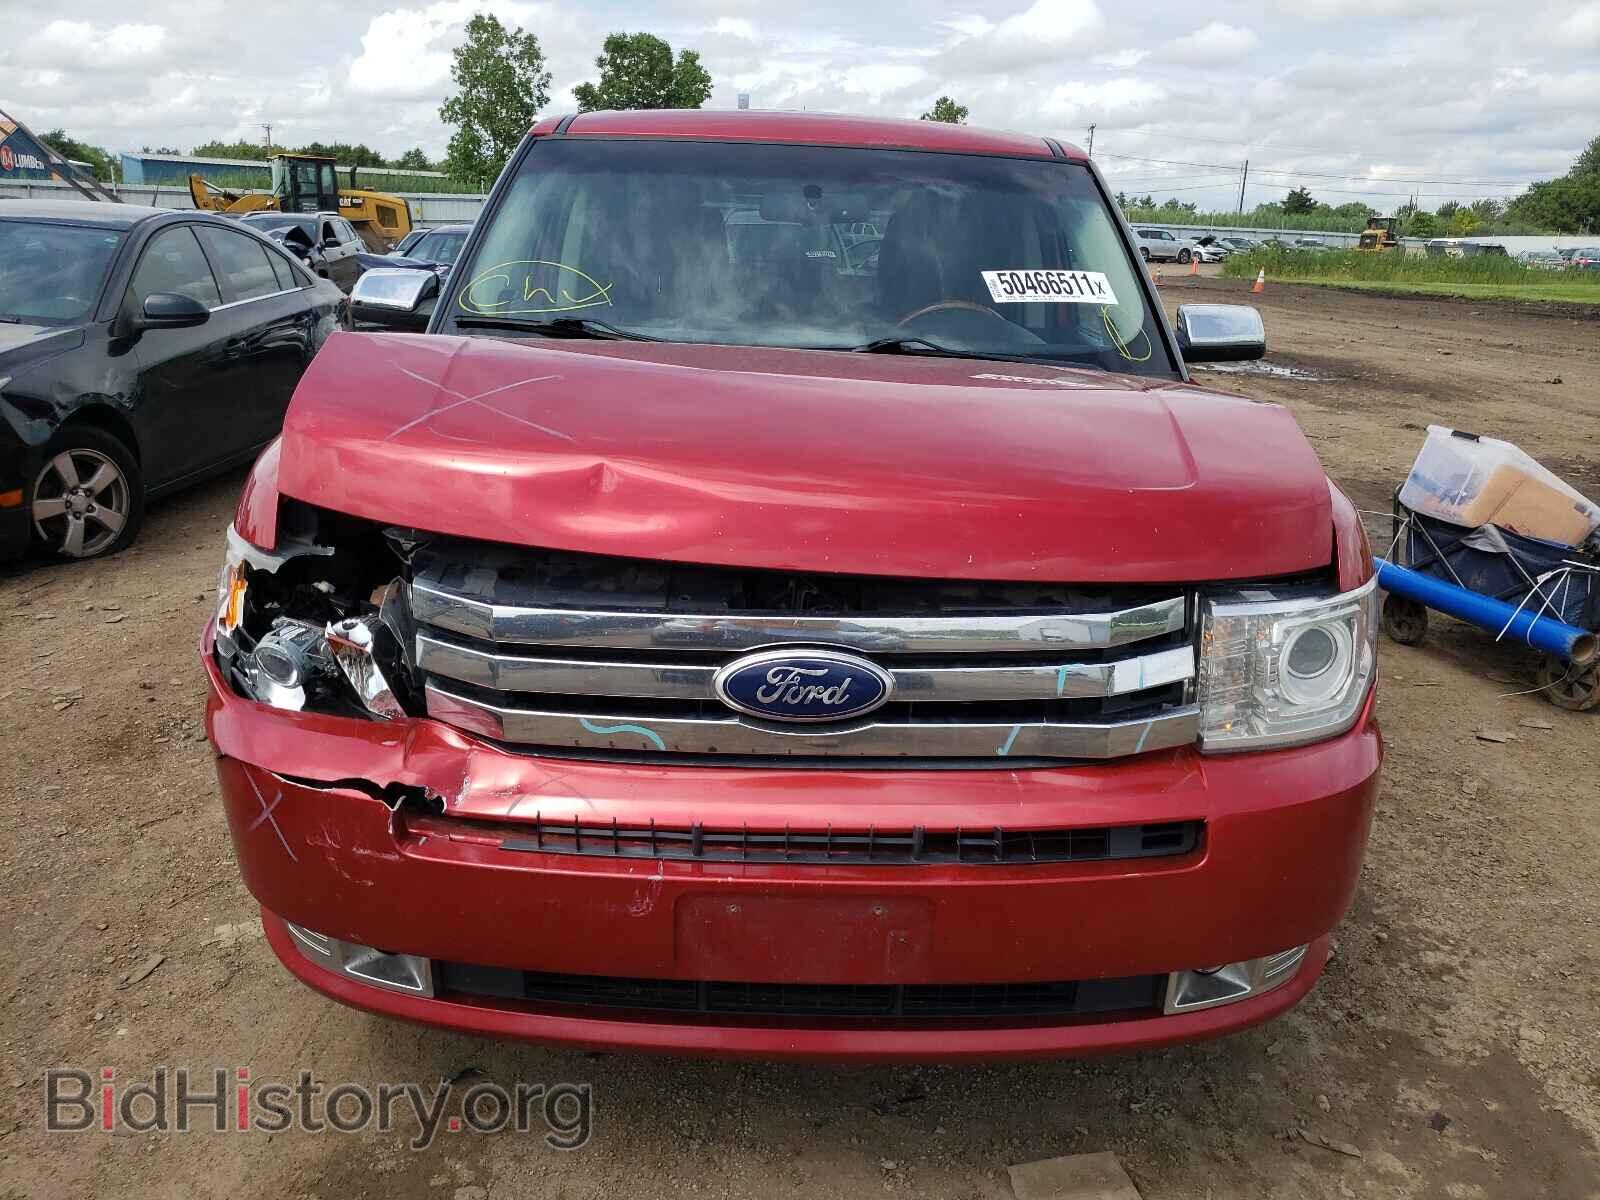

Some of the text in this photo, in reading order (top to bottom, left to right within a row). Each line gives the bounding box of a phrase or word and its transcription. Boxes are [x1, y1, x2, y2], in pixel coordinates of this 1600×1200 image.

[339, 198, 352, 207] CAT
[996, 271, 1096, 296] 50466511
[756, 666, 852, 705] Ford
